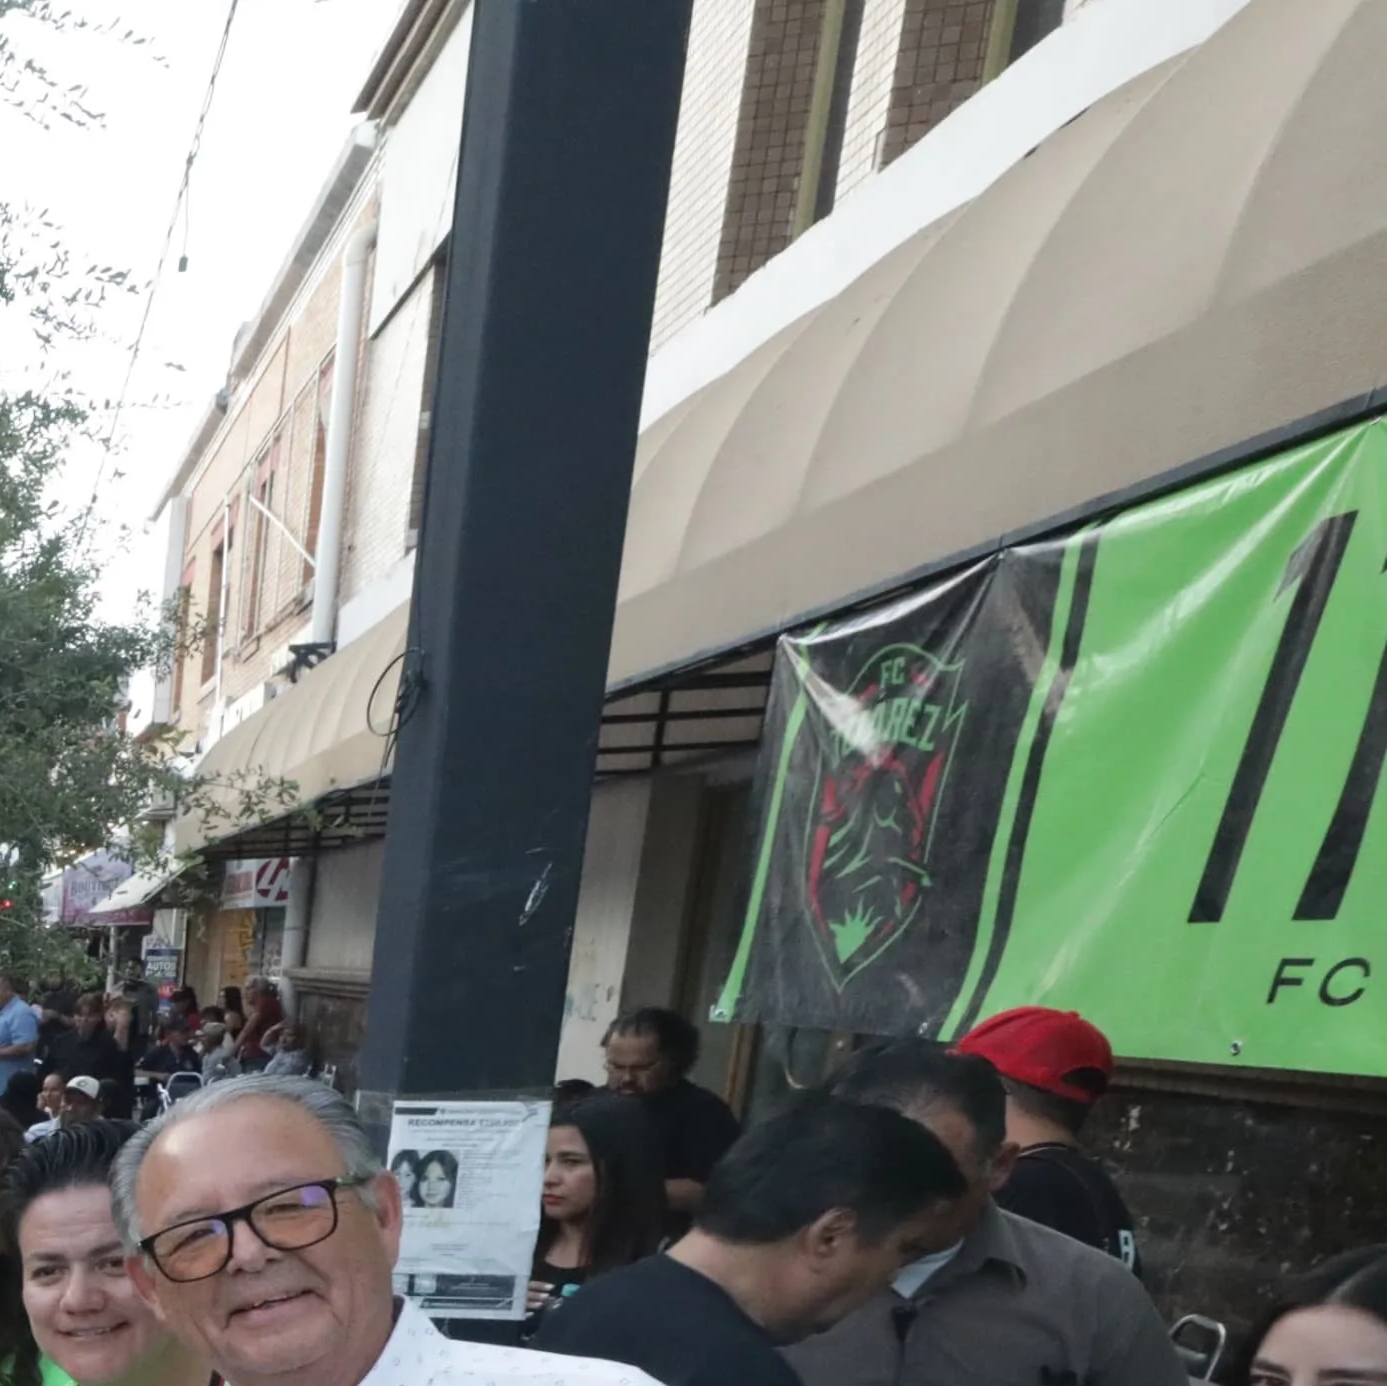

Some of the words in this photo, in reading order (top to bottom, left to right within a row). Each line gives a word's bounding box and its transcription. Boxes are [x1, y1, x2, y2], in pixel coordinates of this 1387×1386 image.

[881, 656, 906, 686] FC
[1267, 957, 1370, 1006] FC
[408, 1118, 476, 1127] RECOMPENSA
